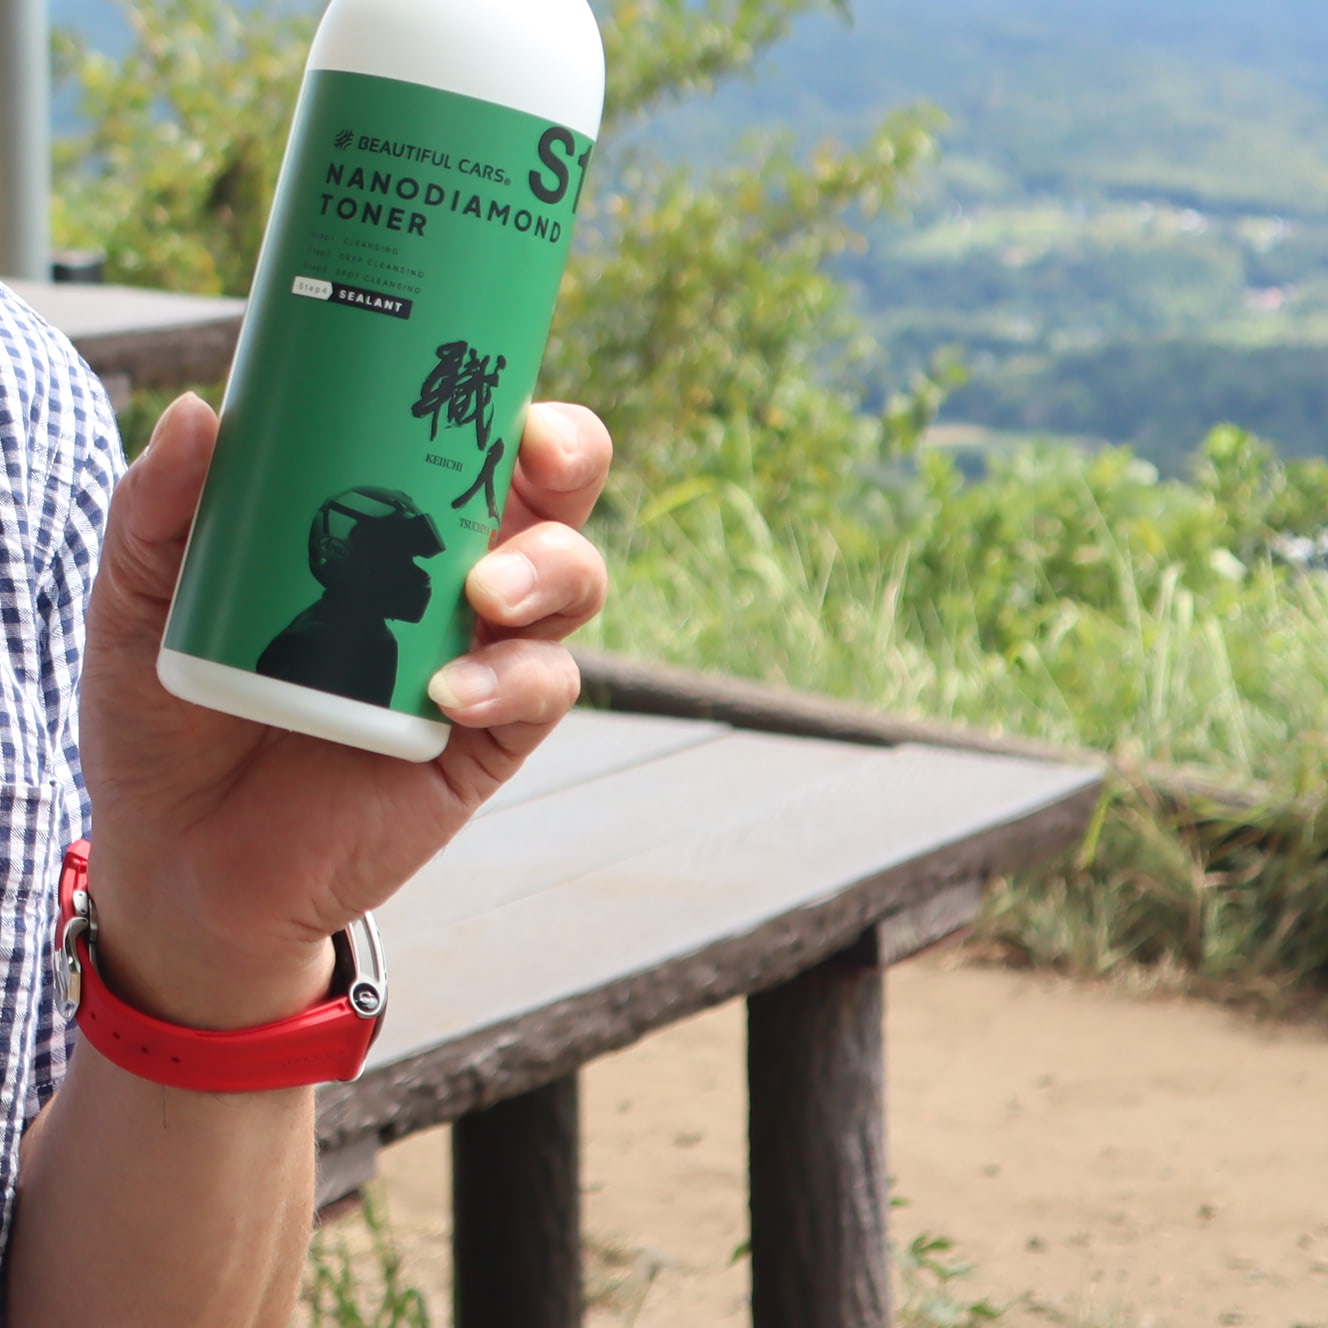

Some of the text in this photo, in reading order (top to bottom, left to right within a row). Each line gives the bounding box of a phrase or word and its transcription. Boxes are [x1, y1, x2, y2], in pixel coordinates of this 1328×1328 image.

[357, 135, 452, 170] BEAUTIFUL
[320, 194, 428, 237] TONER
[325, 162, 562, 244] NANODIAMOND
[298, 281, 403, 313] Step4 SEALANT
[424, 452, 464, 473] KEIICHI
